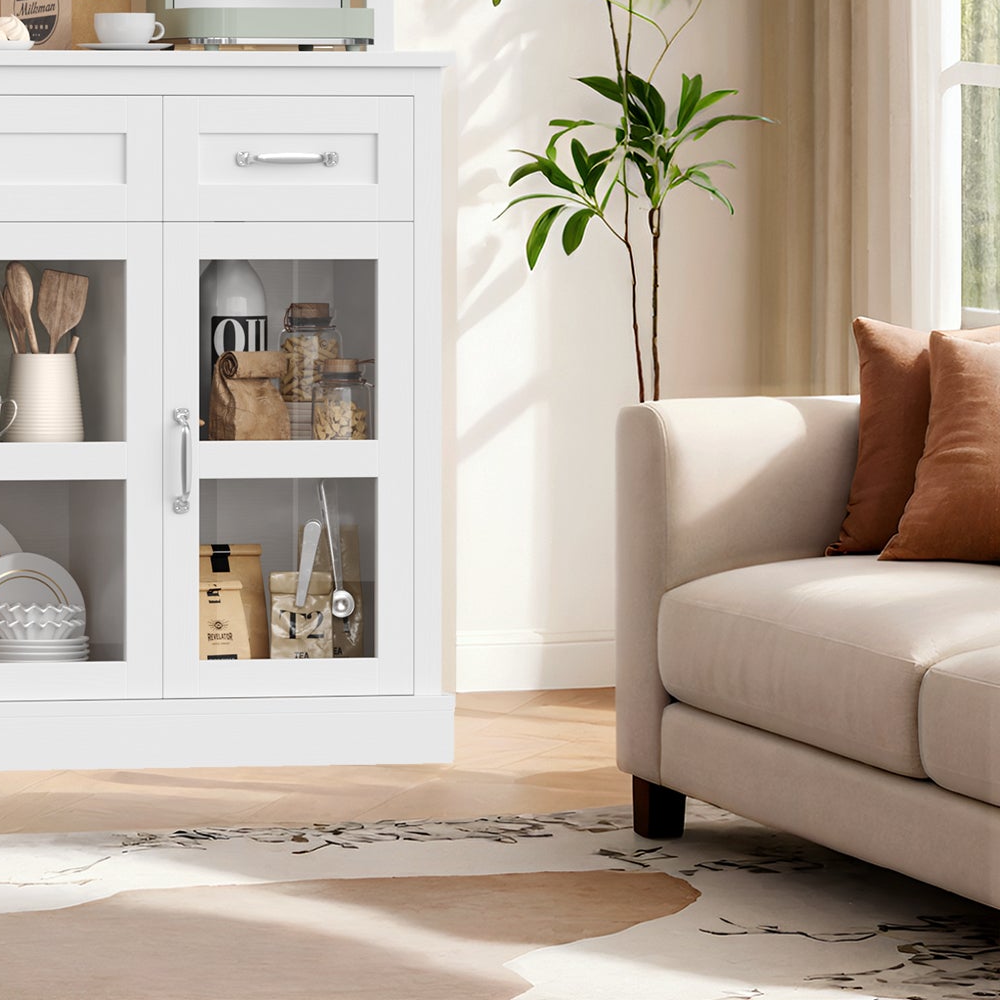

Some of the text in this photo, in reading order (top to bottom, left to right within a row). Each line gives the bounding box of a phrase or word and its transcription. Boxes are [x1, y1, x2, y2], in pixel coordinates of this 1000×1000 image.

[16, 1, 56, 17] Milkman
[279, 609, 325, 639] T2
[207, 632, 233, 642] REVELATOR
[333, 646, 343, 656] EA
